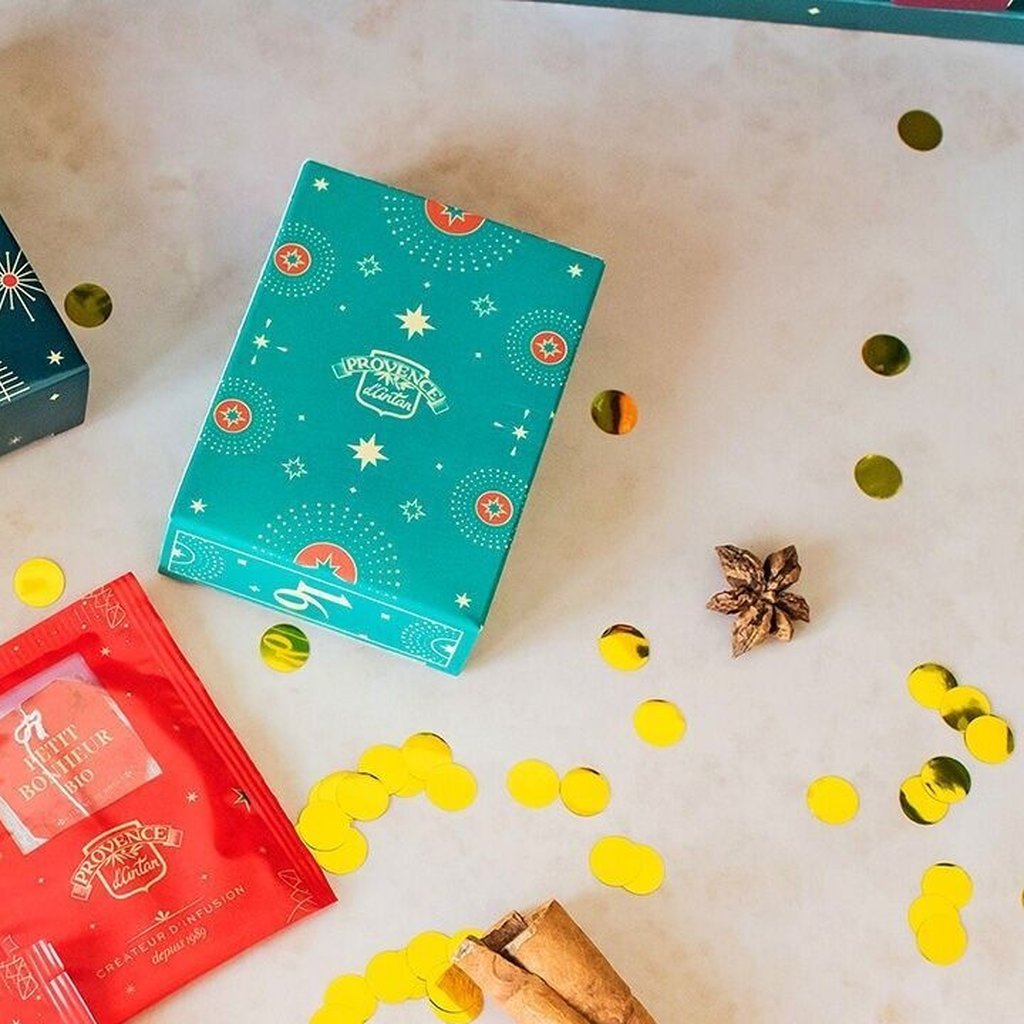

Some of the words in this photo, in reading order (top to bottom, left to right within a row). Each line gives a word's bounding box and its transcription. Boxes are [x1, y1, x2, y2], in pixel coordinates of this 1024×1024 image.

[345, 356, 447, 403] PROVENCE
[273, 579, 353, 620] 16
[64, 767, 96, 795] BIO
[74, 825, 169, 884] PROVENCE
[184, 926, 208, 949] 1989
